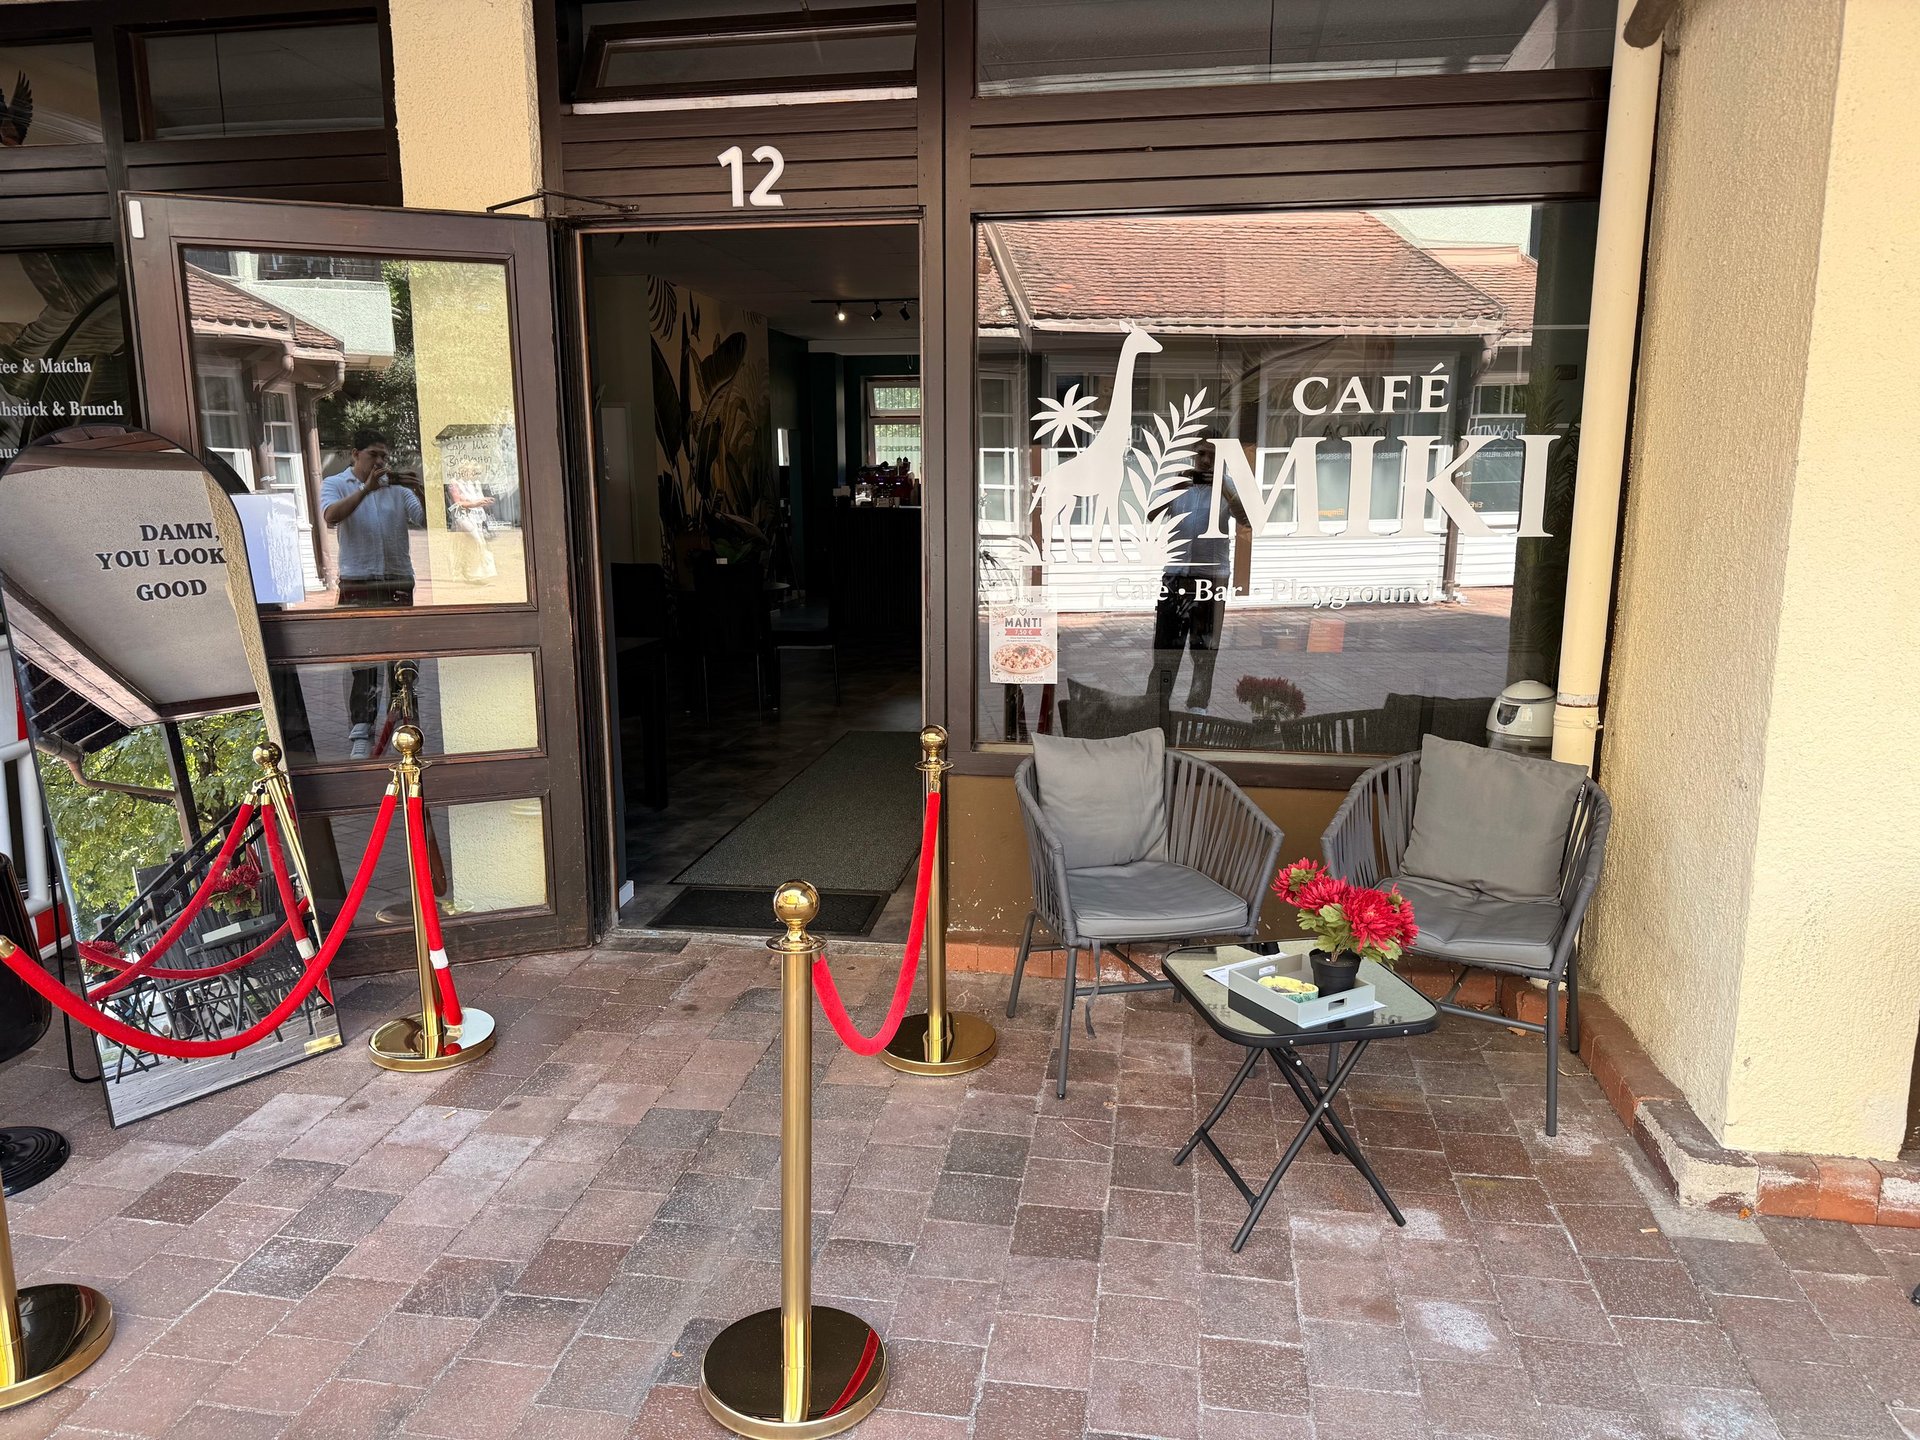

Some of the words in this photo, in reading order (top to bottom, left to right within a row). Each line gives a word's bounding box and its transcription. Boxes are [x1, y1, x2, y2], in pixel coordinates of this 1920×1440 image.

[717, 145, 785, 208] 12
[22, 357, 36, 374] &
[39, 357, 92, 374] Matcha
[1292, 362, 1450, 416] CAFÉ
[52, 400, 66, 417] &
[69, 400, 124, 416] Brunch
[1197, 434, 1561, 539] MIKI
[140, 522, 220, 543] DAMN,
[96, 550, 150, 570] YOU
[159, 547, 227, 567] LOOK
[136, 579, 207, 601] GOOD
[1194, 579, 1243, 602] Bar
[1271, 578, 1435, 610] Playground
[1004, 617, 1042, 628] MANTI
